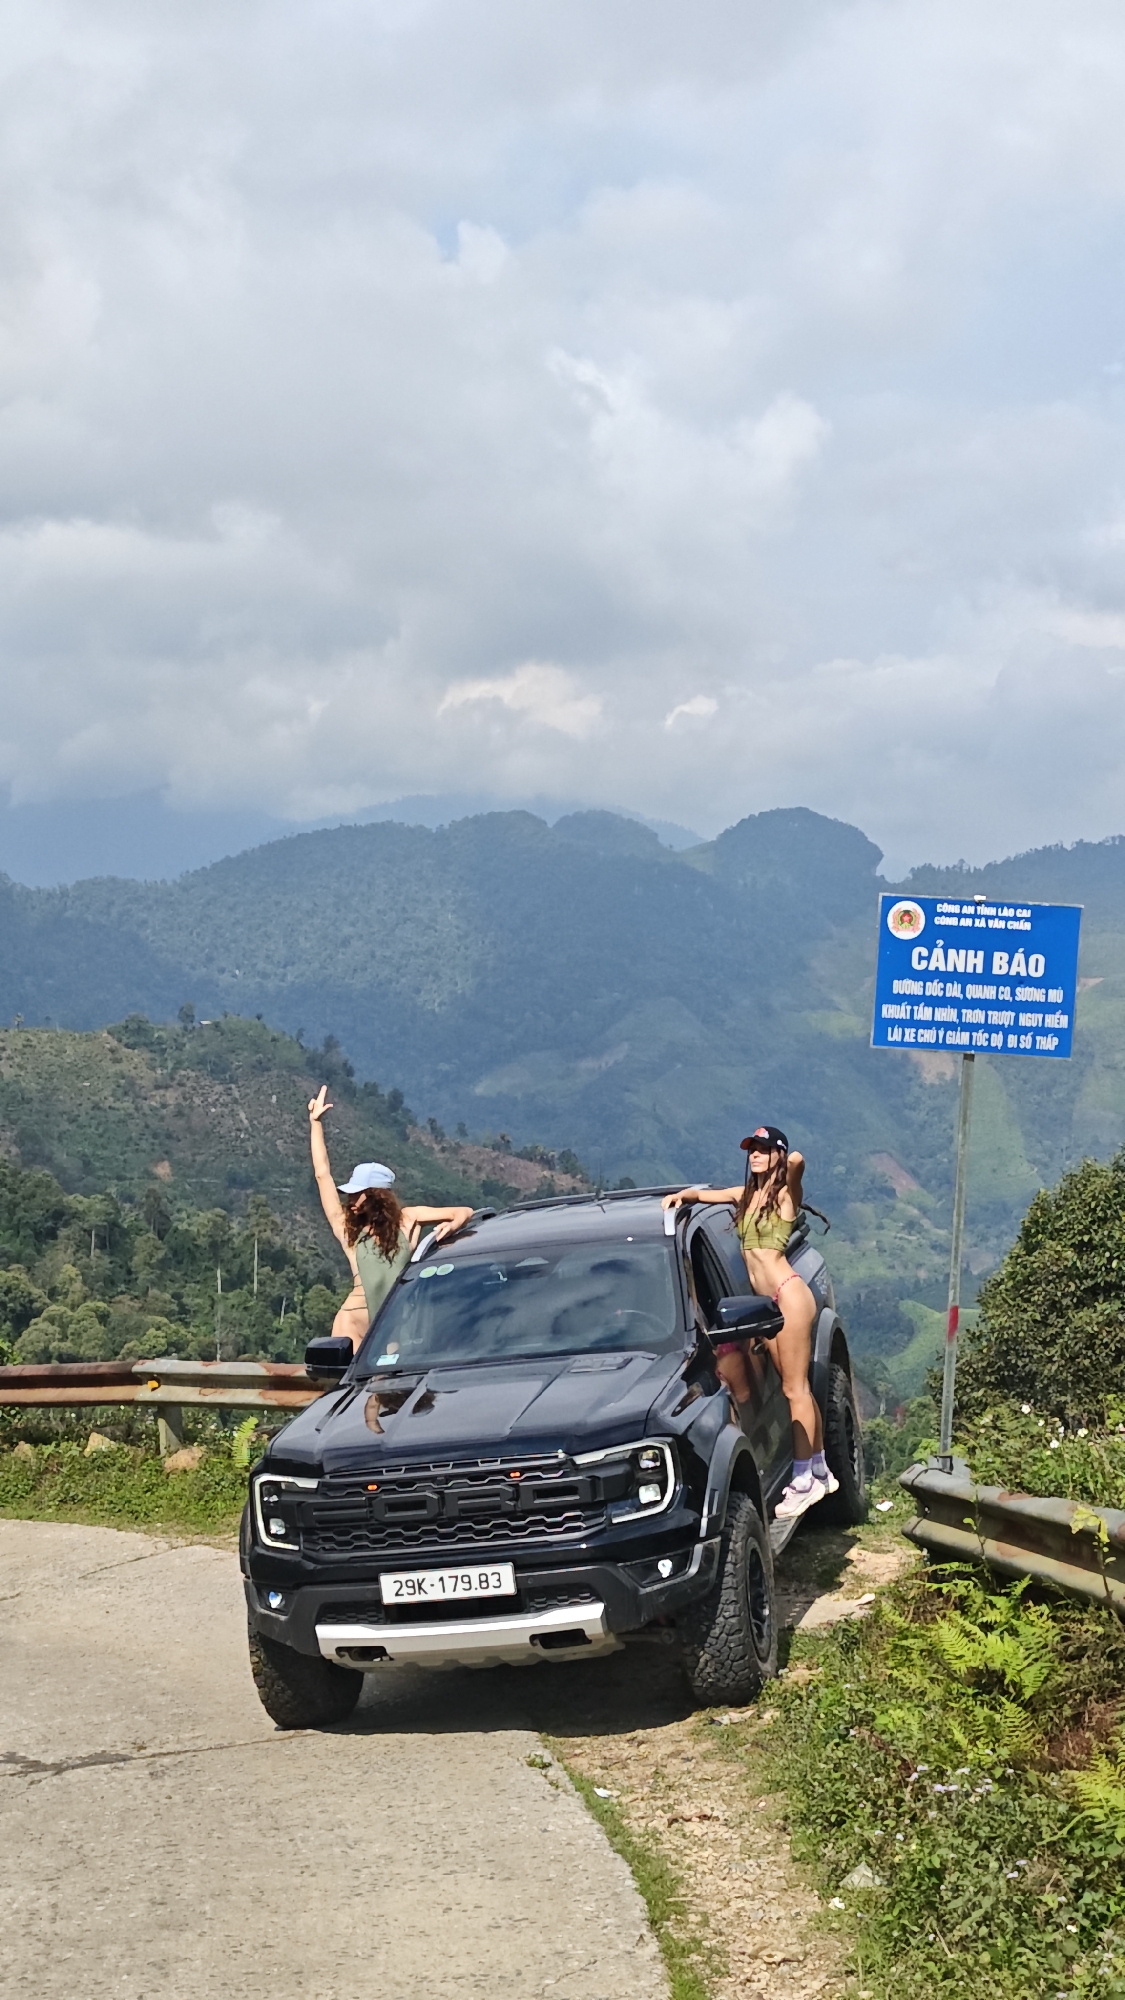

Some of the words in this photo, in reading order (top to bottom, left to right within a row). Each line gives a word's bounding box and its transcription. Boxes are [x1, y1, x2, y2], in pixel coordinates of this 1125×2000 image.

[934, 915, 958, 926] CÔNG
[959, 918, 972, 926] AN
[937, 903, 960, 913] CÔNG
[962, 906, 974, 914] AN
[998, 906, 1014, 917] LÀO
[1016, 909, 1031, 918] CAI
[911, 940, 984, 973] CẢNH
[992, 948, 1045, 977] BÁO
[893, 978, 923, 995] ĐƯỜNG
[925, 979, 944, 997] DỐC
[966, 984, 996, 1000] QUANH
[998, 986, 1012, 1002] CO,
[882, 1001, 911, 1019] KHUẤT
[934, 1005, 959, 1024] NHÌN,
[962, 1008, 985, 1024] TRƠN
[987, 1010, 1016, 1028] TRƯỢT
[1019, 1013, 1043, 1027] NGUY
[887, 1024, 902, 1041] LÁI
[904, 1028, 916, 1042] XE
[918, 1027, 936, 1043] CHÚ
[938, 1027, 944, 1043] Ý
[946, 1027, 970, 1045] GIẢM
[972, 1029, 989, 1046] TỐC
[990, 1031, 1003, 1050] ĐỘ
[1007, 1034, 1018, 1048] ĐI
[1019, 1032, 1033, 1049] SỐ
[1036, 1033, 1059, 1050] THẤP
[301, 1476, 595, 1526] FORD
[392, 1571, 503, 1598] 29K-179.83
